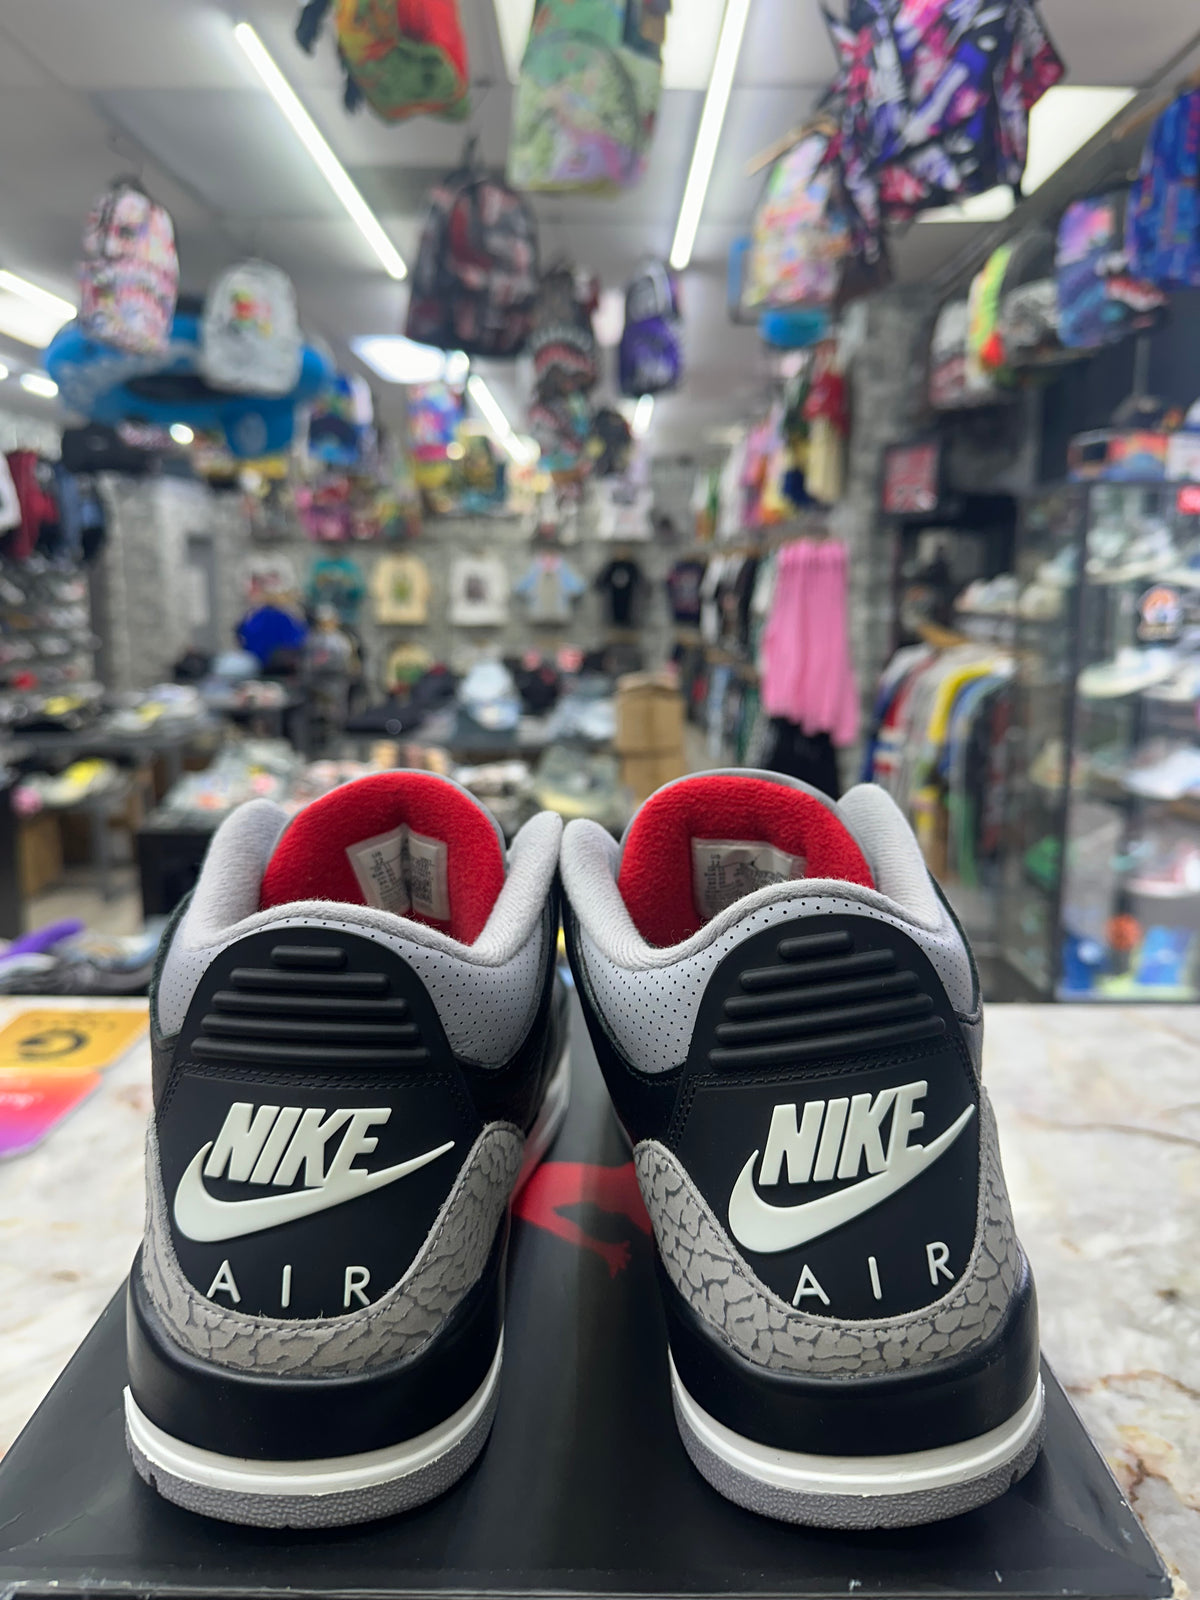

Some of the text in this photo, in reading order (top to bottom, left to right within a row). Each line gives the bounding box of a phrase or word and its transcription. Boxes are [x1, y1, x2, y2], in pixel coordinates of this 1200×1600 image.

[204, 1102, 392, 1187] NIKE
[759, 1080, 928, 1185] NIKE
[206, 1259, 371, 1308] AIR
[792, 1241, 955, 1307] AIR
